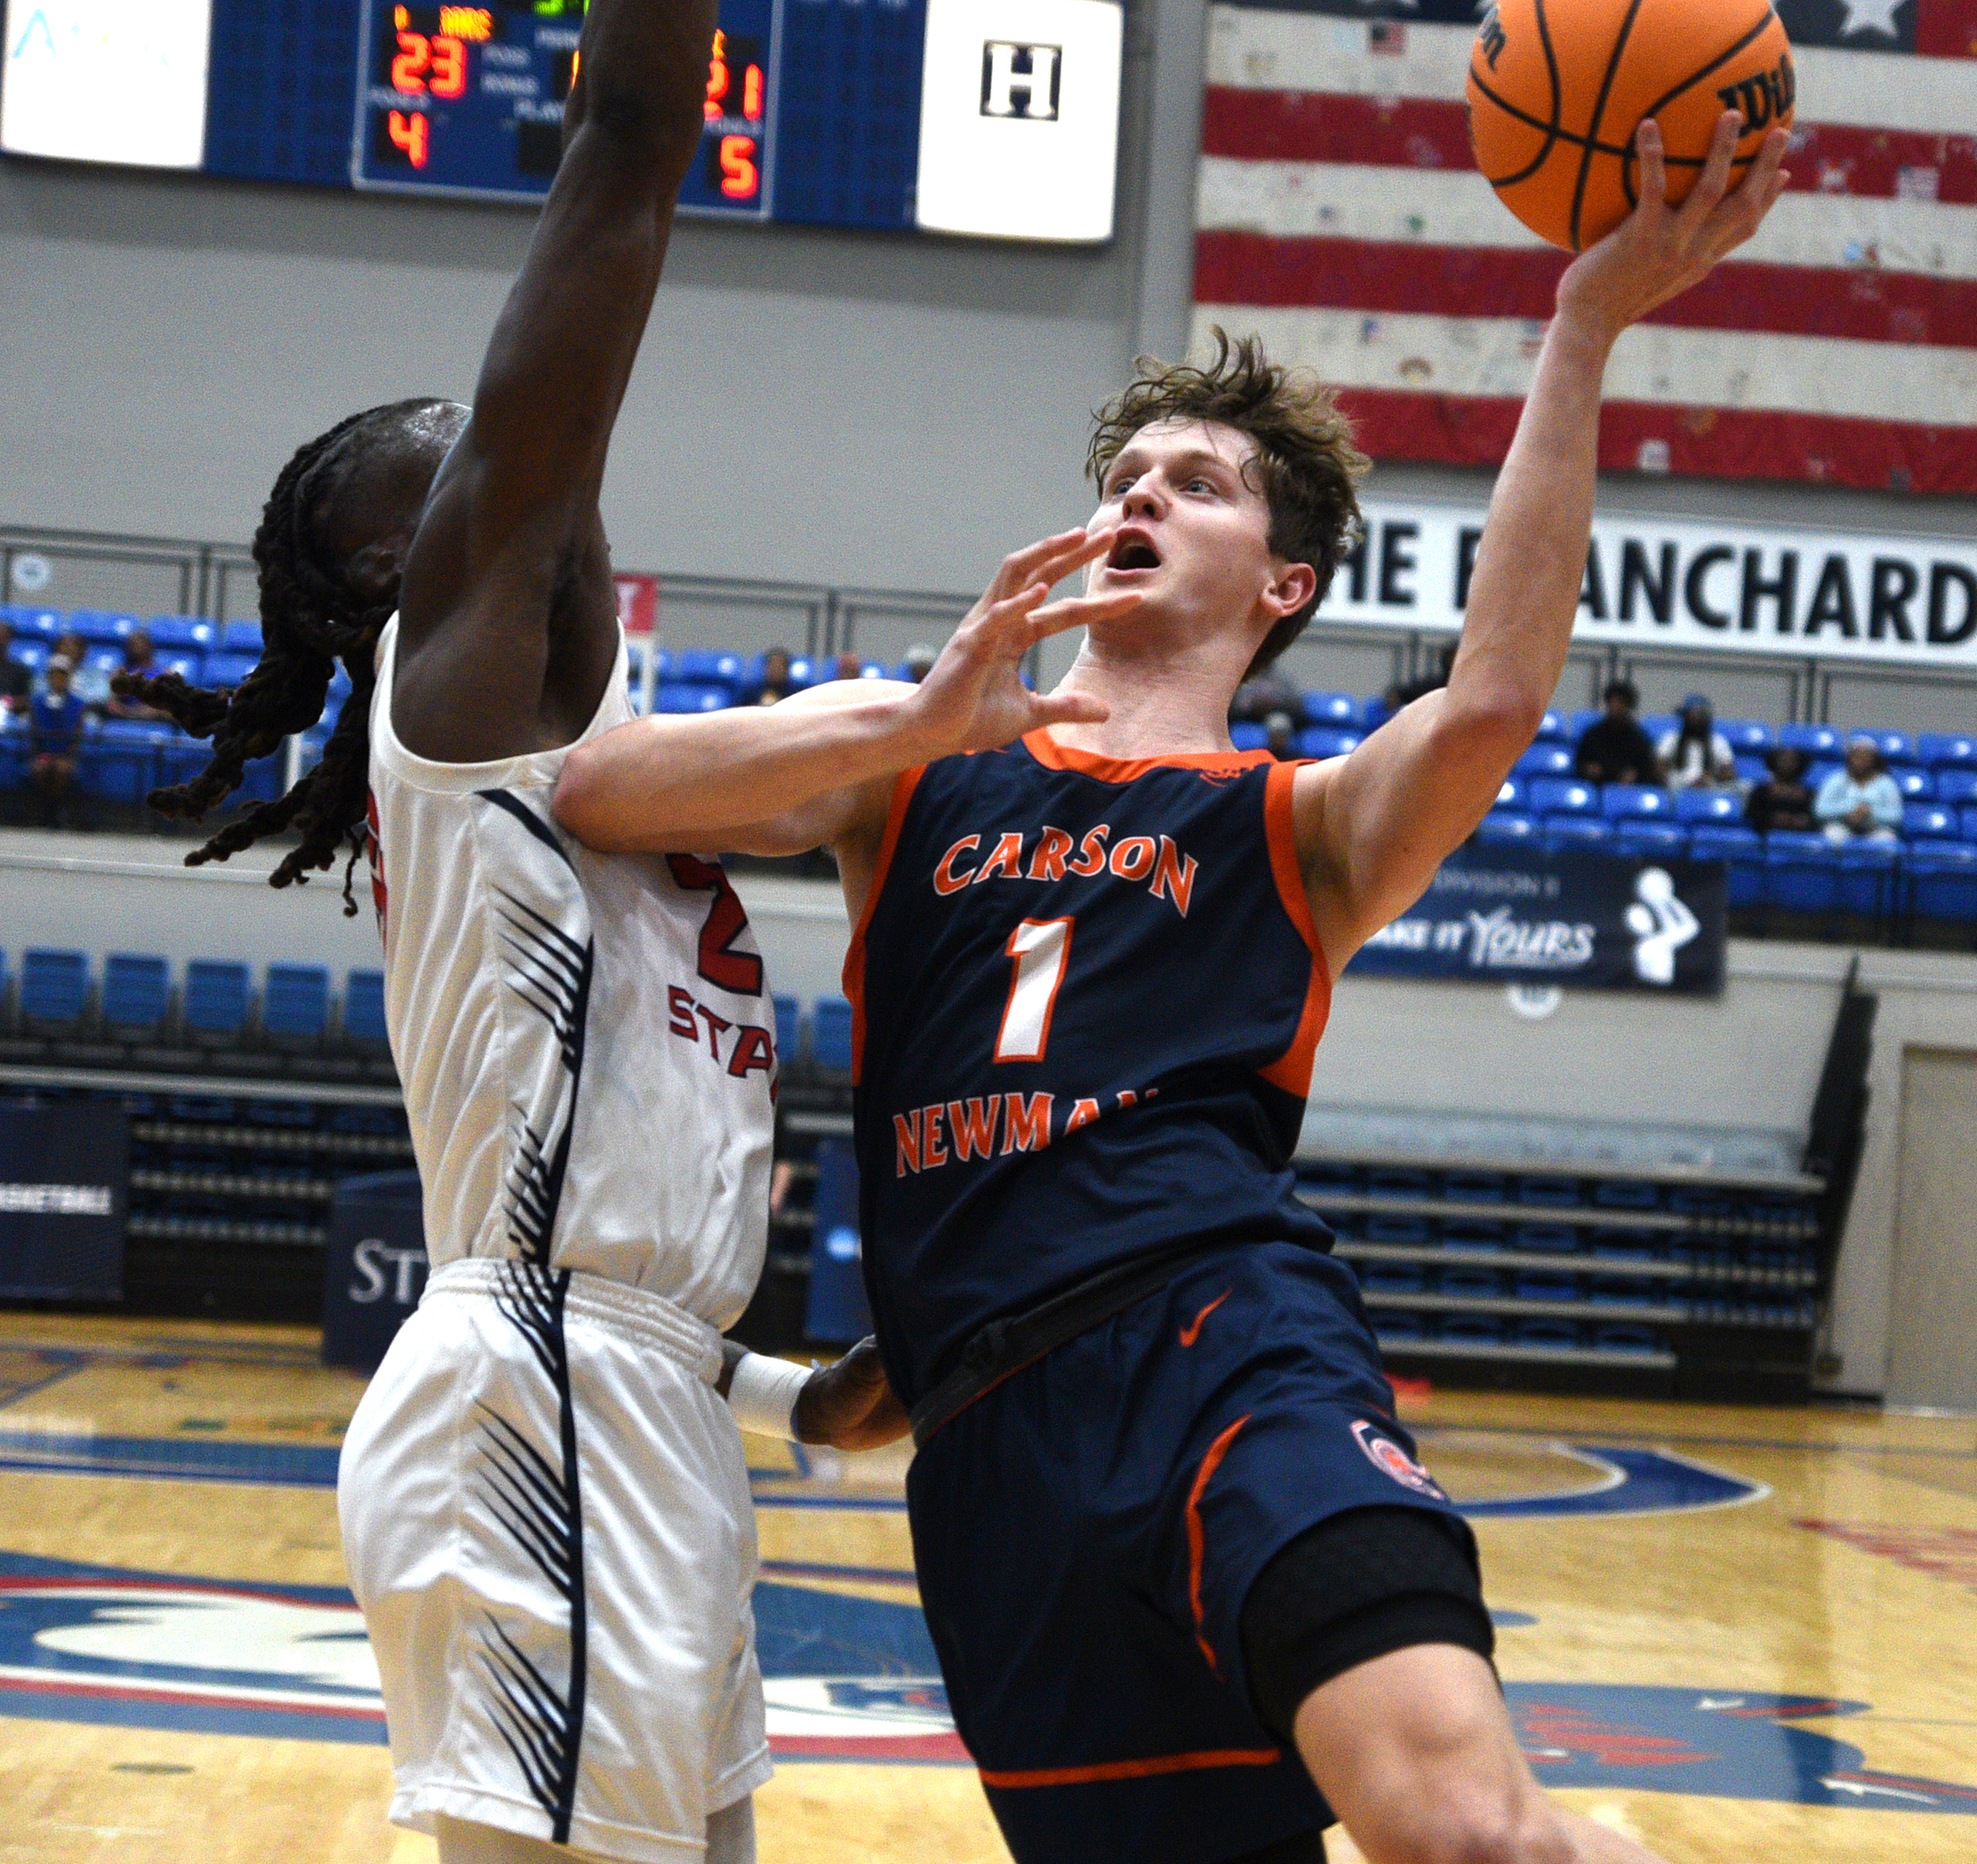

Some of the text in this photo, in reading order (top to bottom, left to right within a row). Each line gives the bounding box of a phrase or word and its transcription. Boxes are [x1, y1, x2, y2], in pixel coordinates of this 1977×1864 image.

[392, 31, 467, 98] 23
[979, 39, 1063, 121] H
[388, 110, 429, 168] 4
[720, 134, 759, 199] 5
[933, 824, 1199, 919] CARSON
[664, 852, 763, 998] 2
[993, 915, 1075, 1064] 1
[667, 984, 779, 1105] STA
[893, 1089, 1160, 1178] NEWMA
